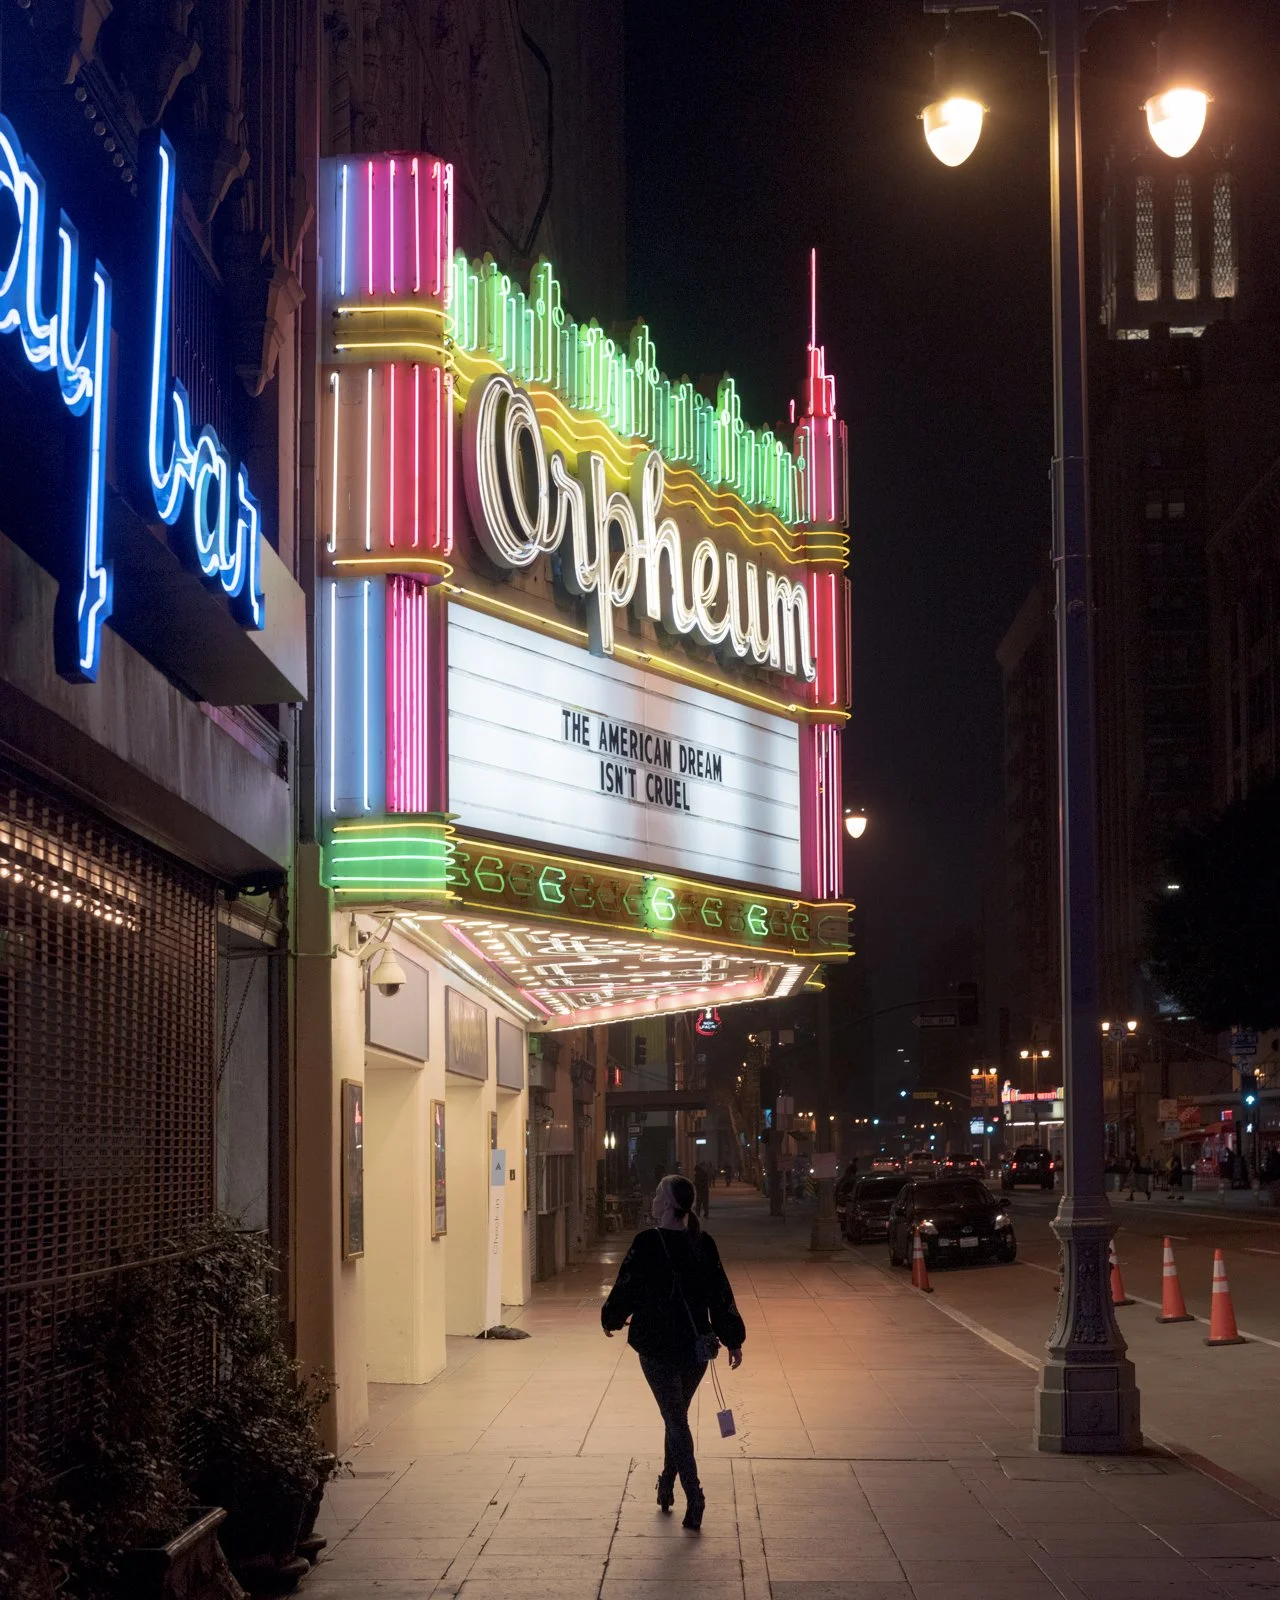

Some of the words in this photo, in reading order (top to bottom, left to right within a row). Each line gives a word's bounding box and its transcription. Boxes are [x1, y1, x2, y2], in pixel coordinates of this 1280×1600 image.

[146, 130, 263, 631] bar
[464, 373, 817, 683] Orpheum
[562, 709, 590, 746] THE
[599, 721, 671, 769] AMERICAN
[679, 744, 722, 782] DREAM
[600, 760, 636, 798] ISN'T
[646, 772, 690, 811] CRUEL
